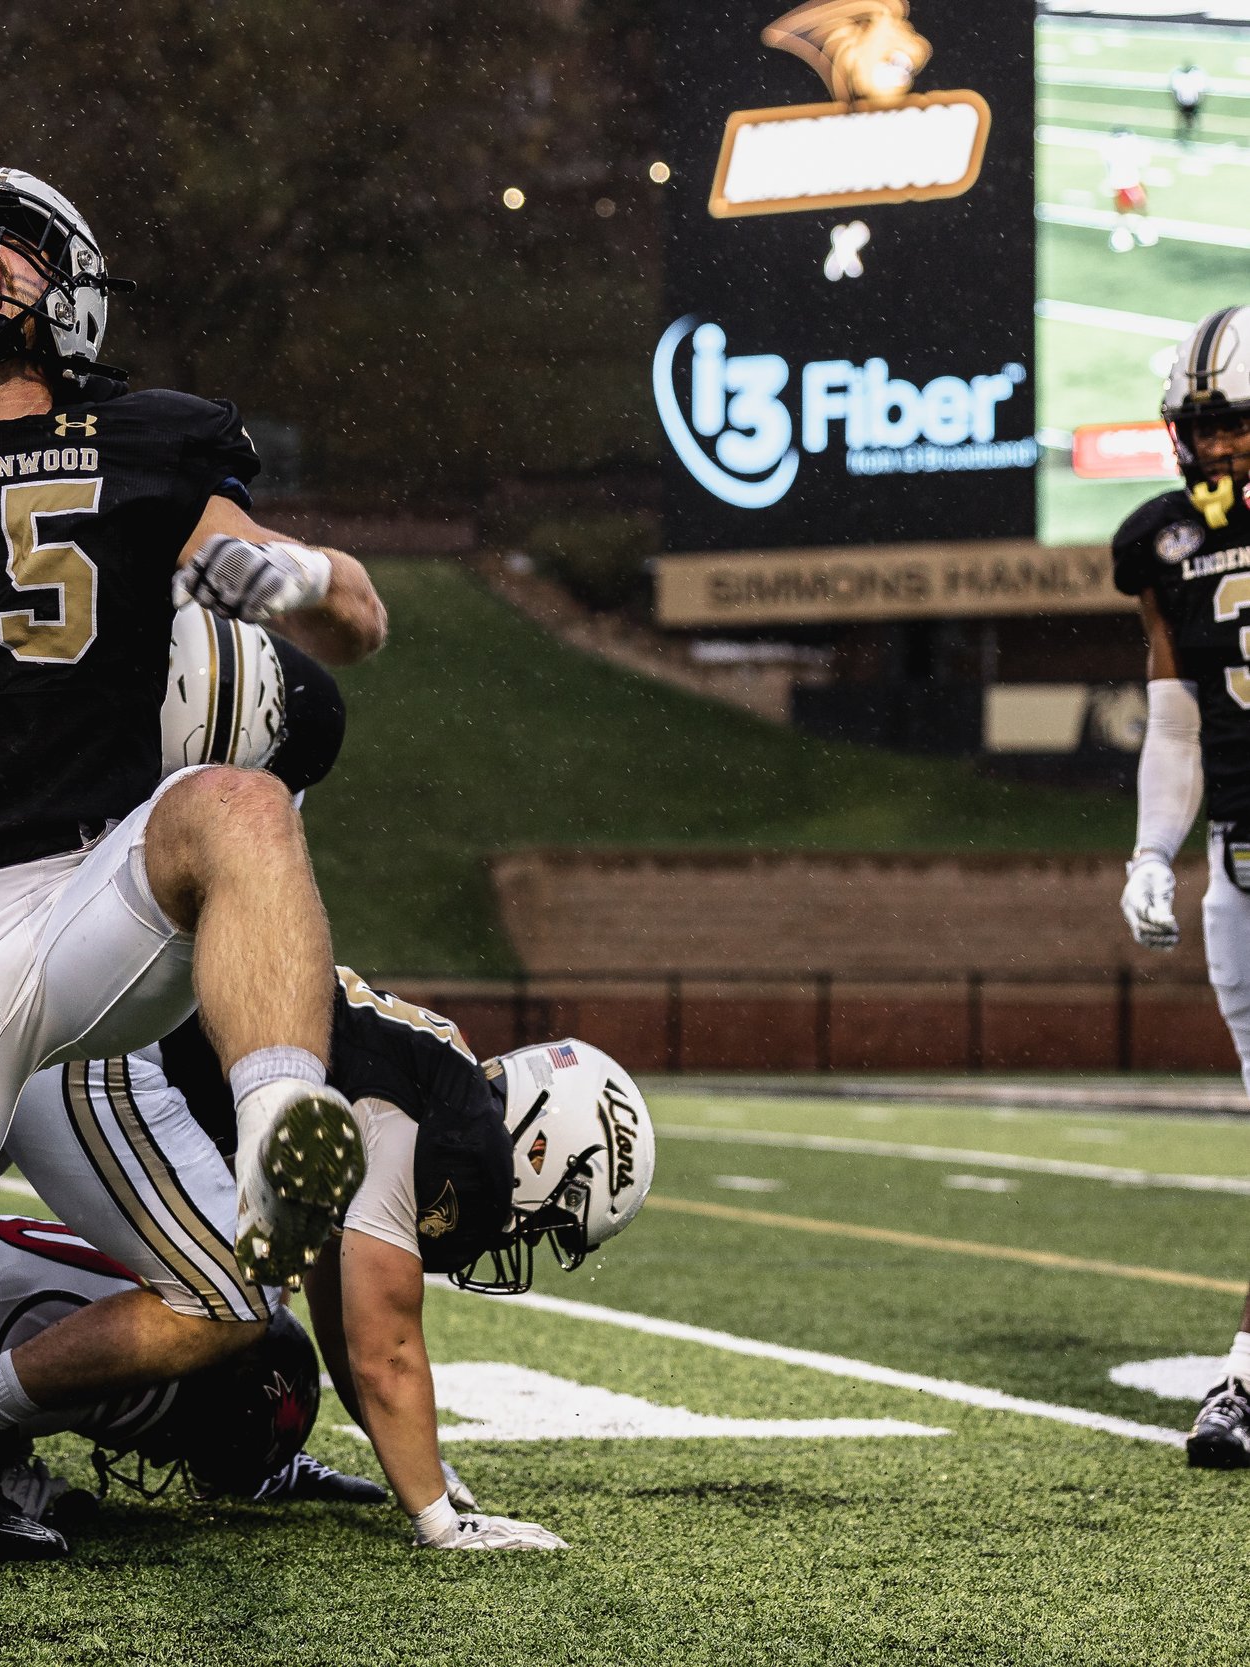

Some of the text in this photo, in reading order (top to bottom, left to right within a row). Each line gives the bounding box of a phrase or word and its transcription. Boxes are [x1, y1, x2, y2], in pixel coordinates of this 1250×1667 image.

[802, 356, 1014, 454] Fiber
[709, 560, 933, 609] SIMMONS
[599, 1089, 638, 1194] Lions
